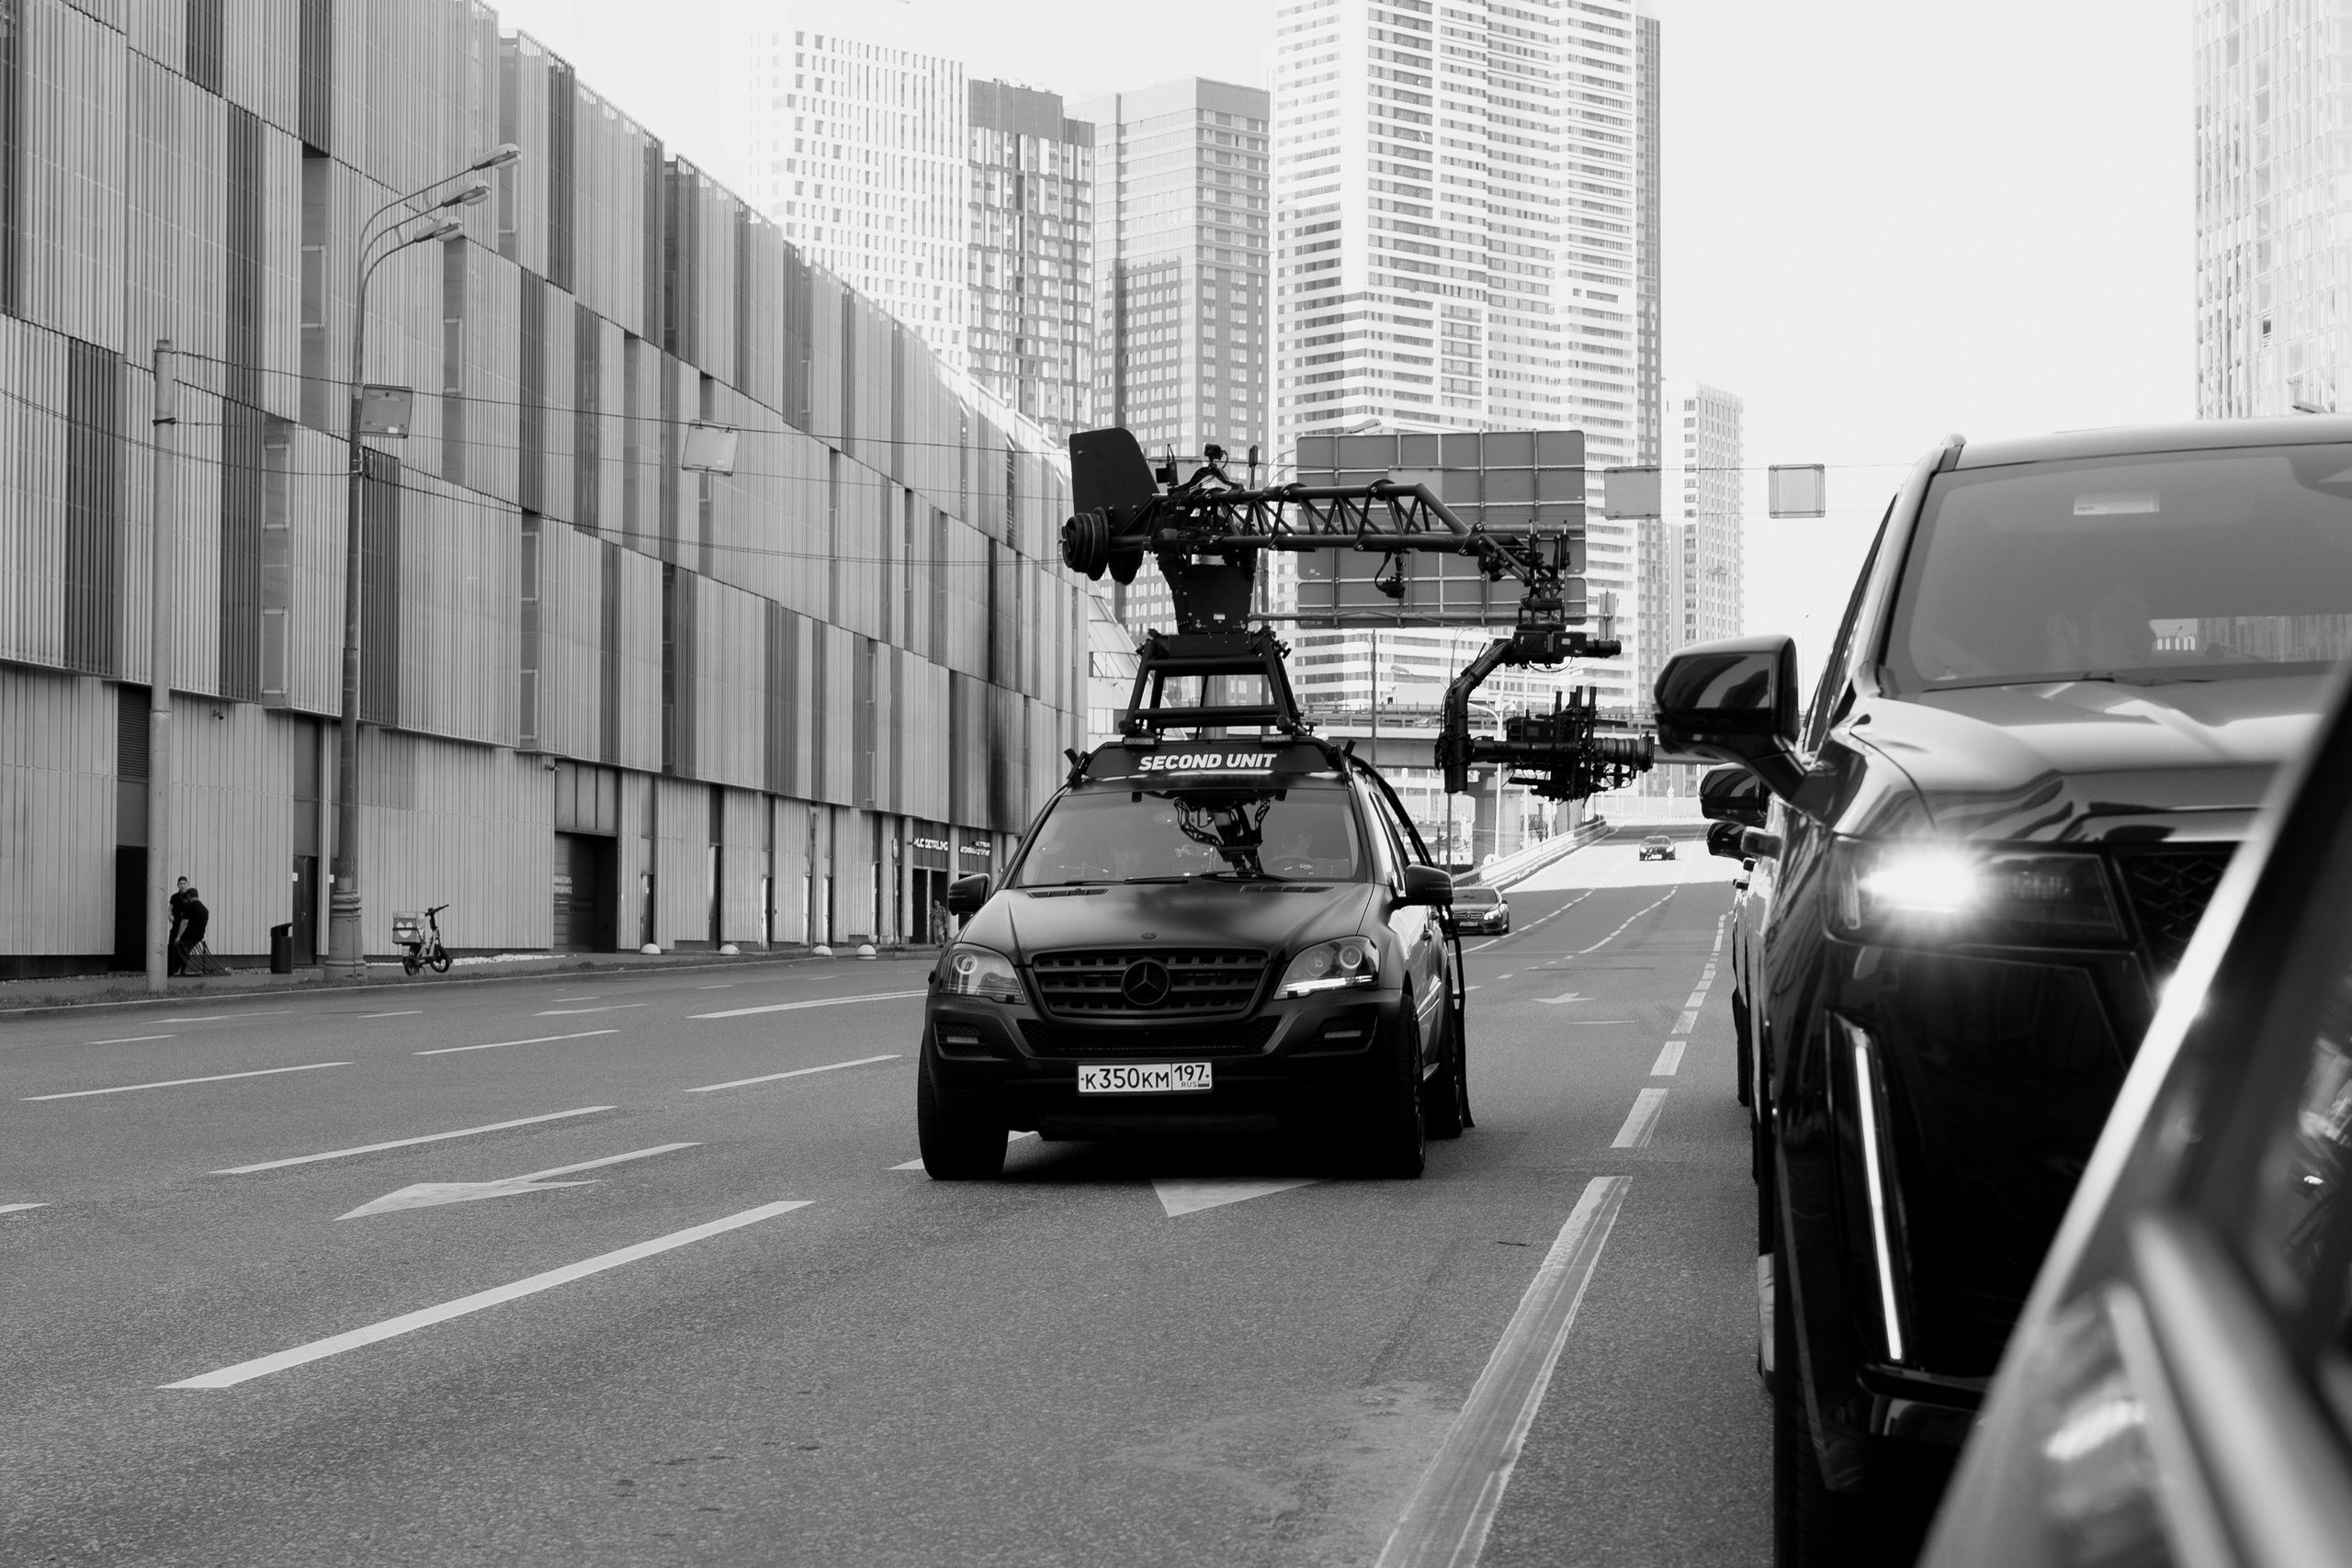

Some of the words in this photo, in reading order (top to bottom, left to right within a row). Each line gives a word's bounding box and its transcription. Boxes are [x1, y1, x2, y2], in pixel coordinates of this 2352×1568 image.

[1138, 753, 1222, 771] SECOND
[1226, 753, 1277, 768] UNIT
[1174, 1065, 1205, 1081] 197
